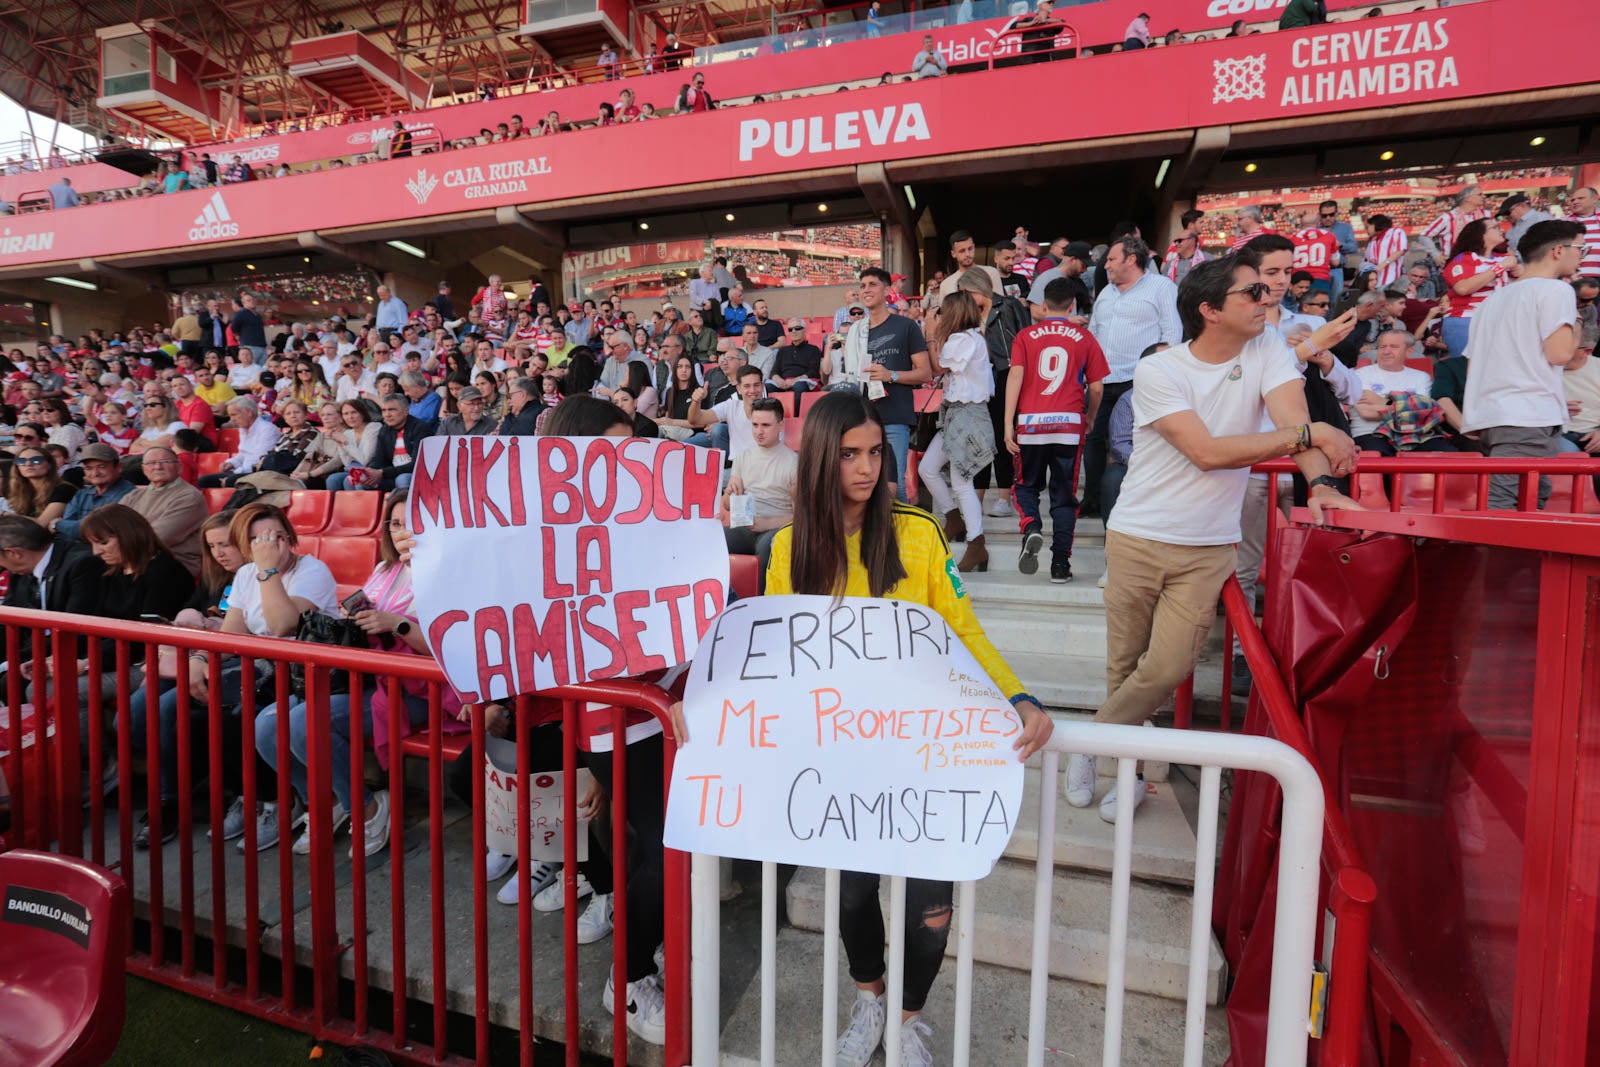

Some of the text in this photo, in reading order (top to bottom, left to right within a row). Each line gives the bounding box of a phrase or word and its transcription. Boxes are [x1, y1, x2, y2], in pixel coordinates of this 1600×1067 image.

[1292, 18, 1449, 69] CERVEZAS
[1280, 56, 1459, 106] ALHAMBRA
[738, 102, 931, 162] PULEVA
[442, 157, 552, 188] CAJA RURAL
[464, 179, 528, 199] GRANADA
[188, 219, 239, 241] adidas
[1294, 243, 1326, 268] 50
[1038, 346, 1069, 395] 9
[1038, 415, 1070, 424] LIDERA
[537, 436, 721, 525] BOSCH
[541, 525, 613, 599] LA
[717, 687, 1019, 749] ME PROMETISTES
[916, 742, 949, 772] 13
[686, 775, 743, 828] TU
[8, 899, 89, 936] BANQUILLO AUXILIAR
